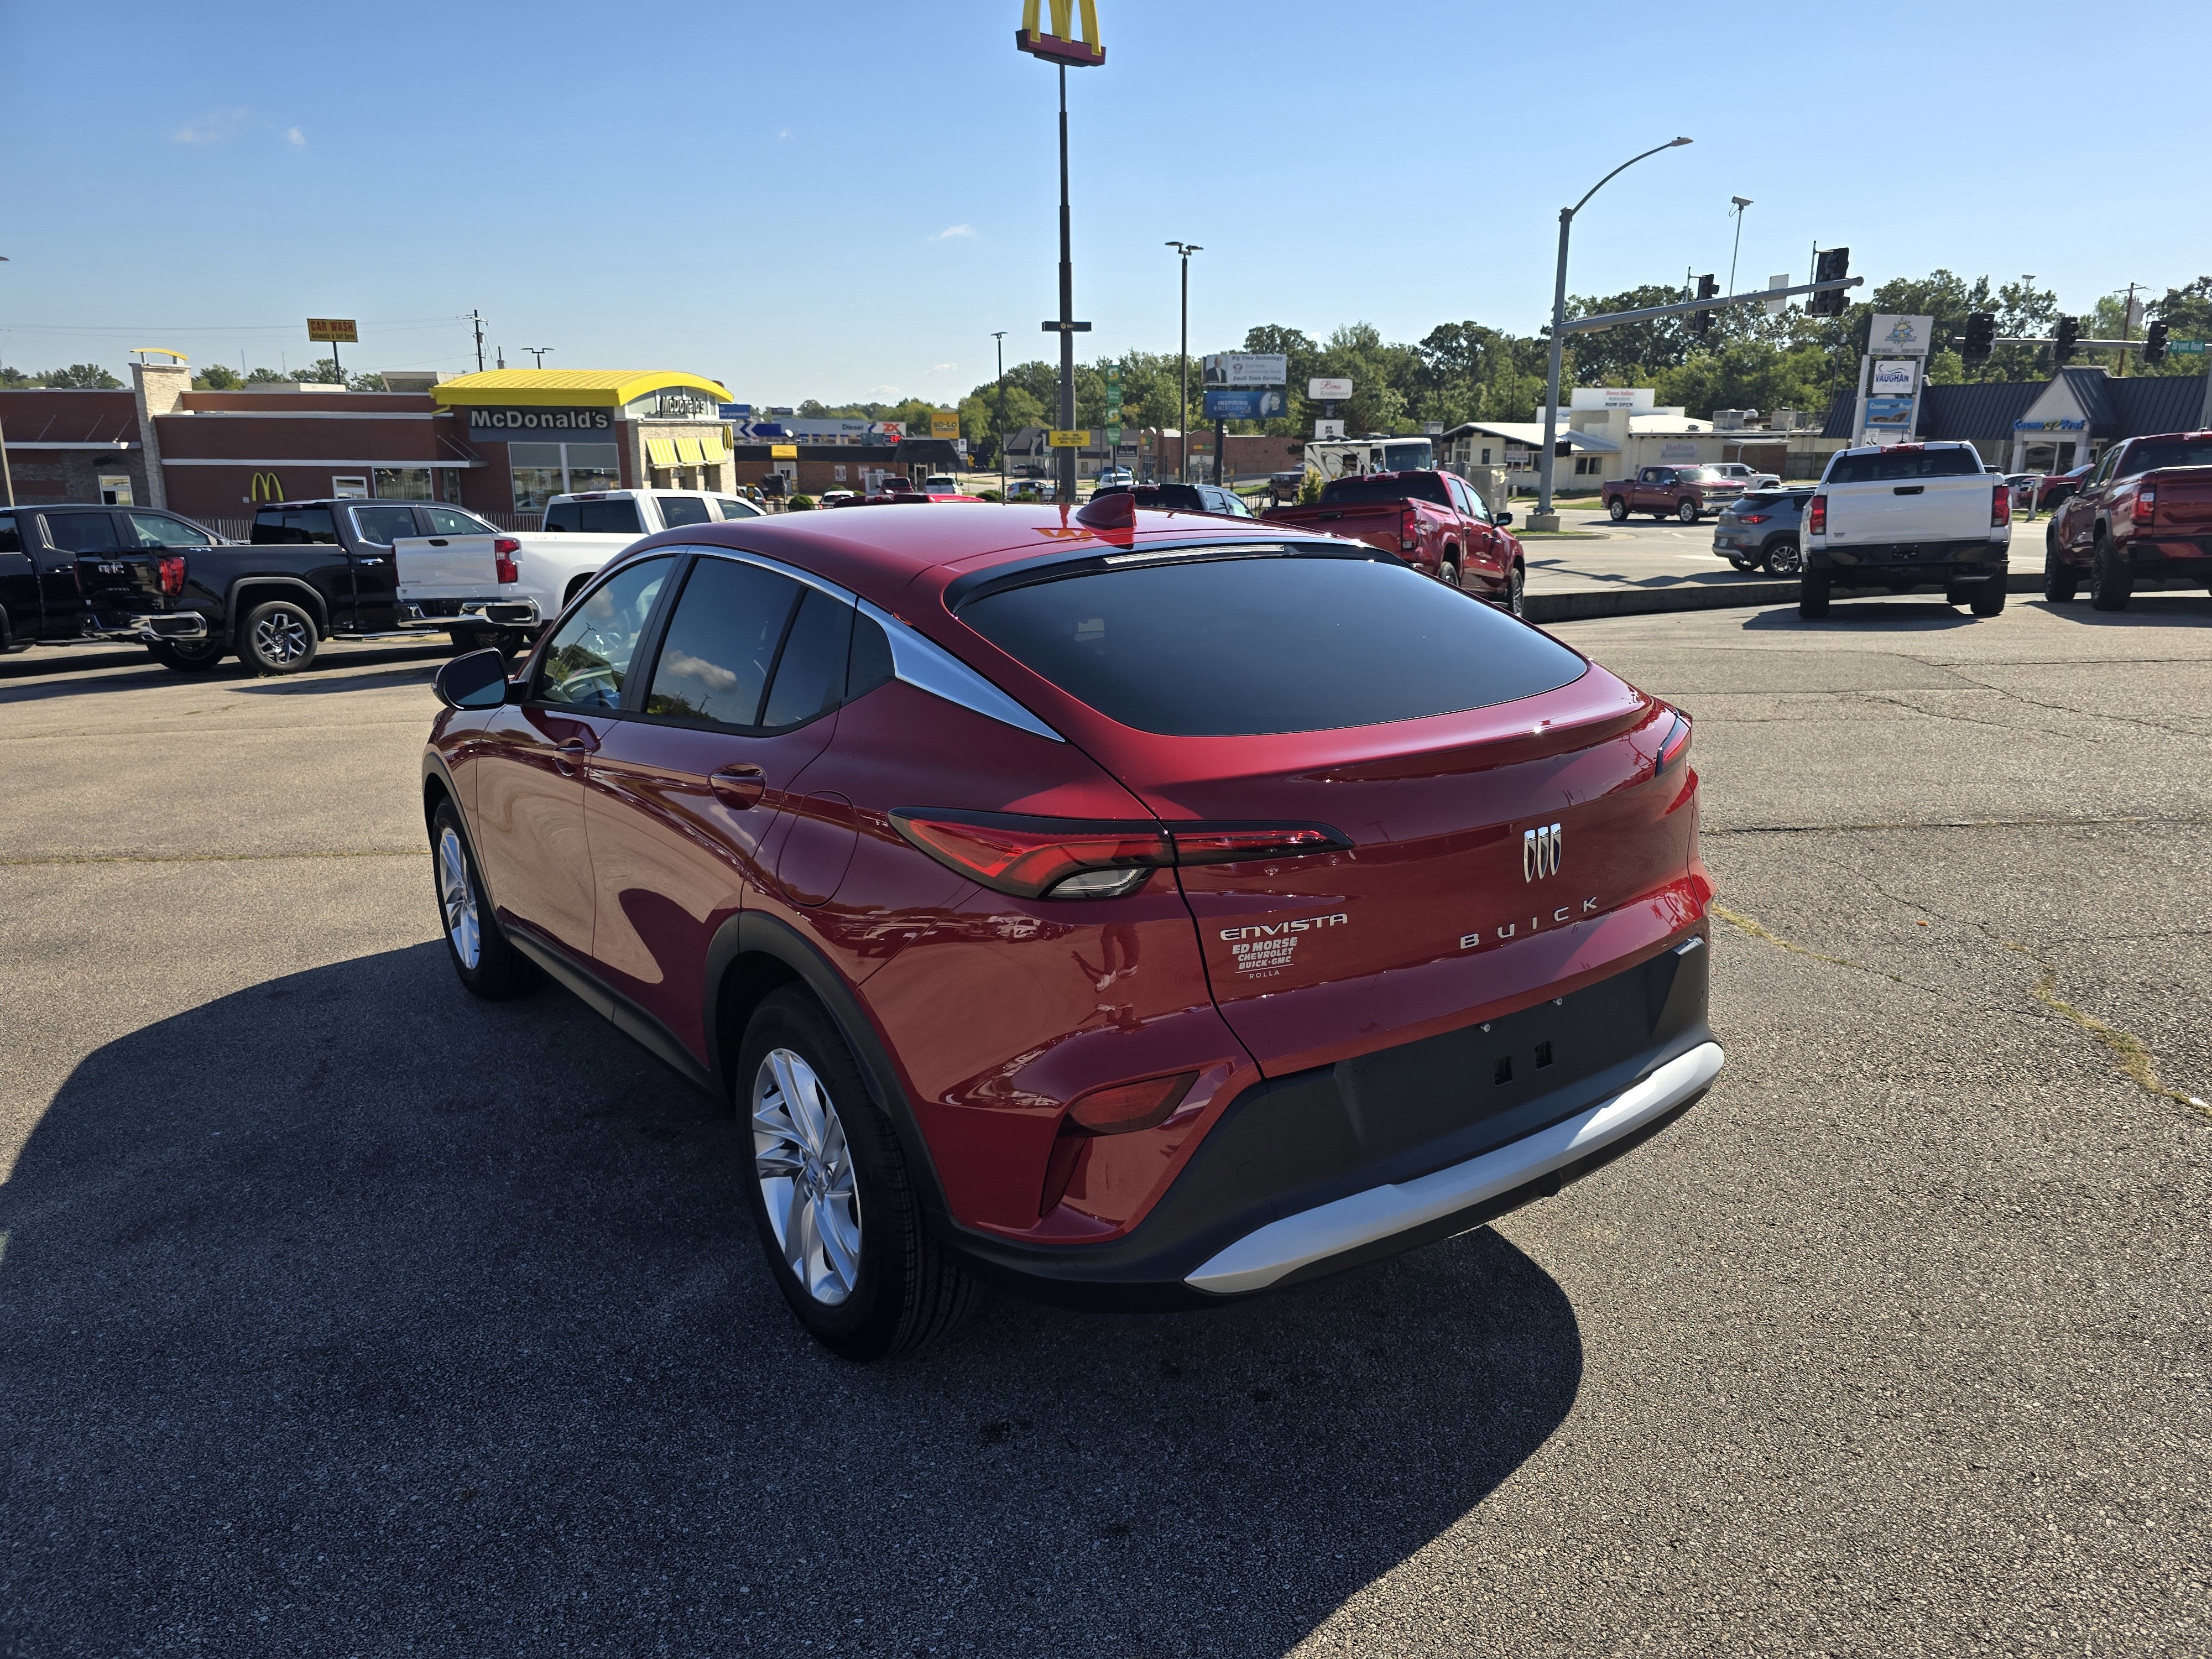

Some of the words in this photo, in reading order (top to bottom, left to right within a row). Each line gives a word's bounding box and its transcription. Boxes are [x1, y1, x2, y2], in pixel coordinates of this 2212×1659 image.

[310, 321, 327, 331] CAR
[330, 321, 353, 332] WASH
[2172, 341, 2189, 352] Bryant
[2190, 341, 2203, 351] Road
[1875, 374, 1909, 382] VAUGHAN
[471, 411, 608, 428] McDonald's
[2013, 419, 2045, 430] Cosmo
[2061, 420, 2085, 430] Prof
[1219, 913, 1348, 941] ENVISTA
[1460, 896, 1598, 950] BUICK
[1232, 943, 1250, 954] ED
[1252, 936, 1298, 952] MORSE
[1238, 947, 1293, 962] CHEVROLET
[1249, 969, 1280, 979] ROLLA
